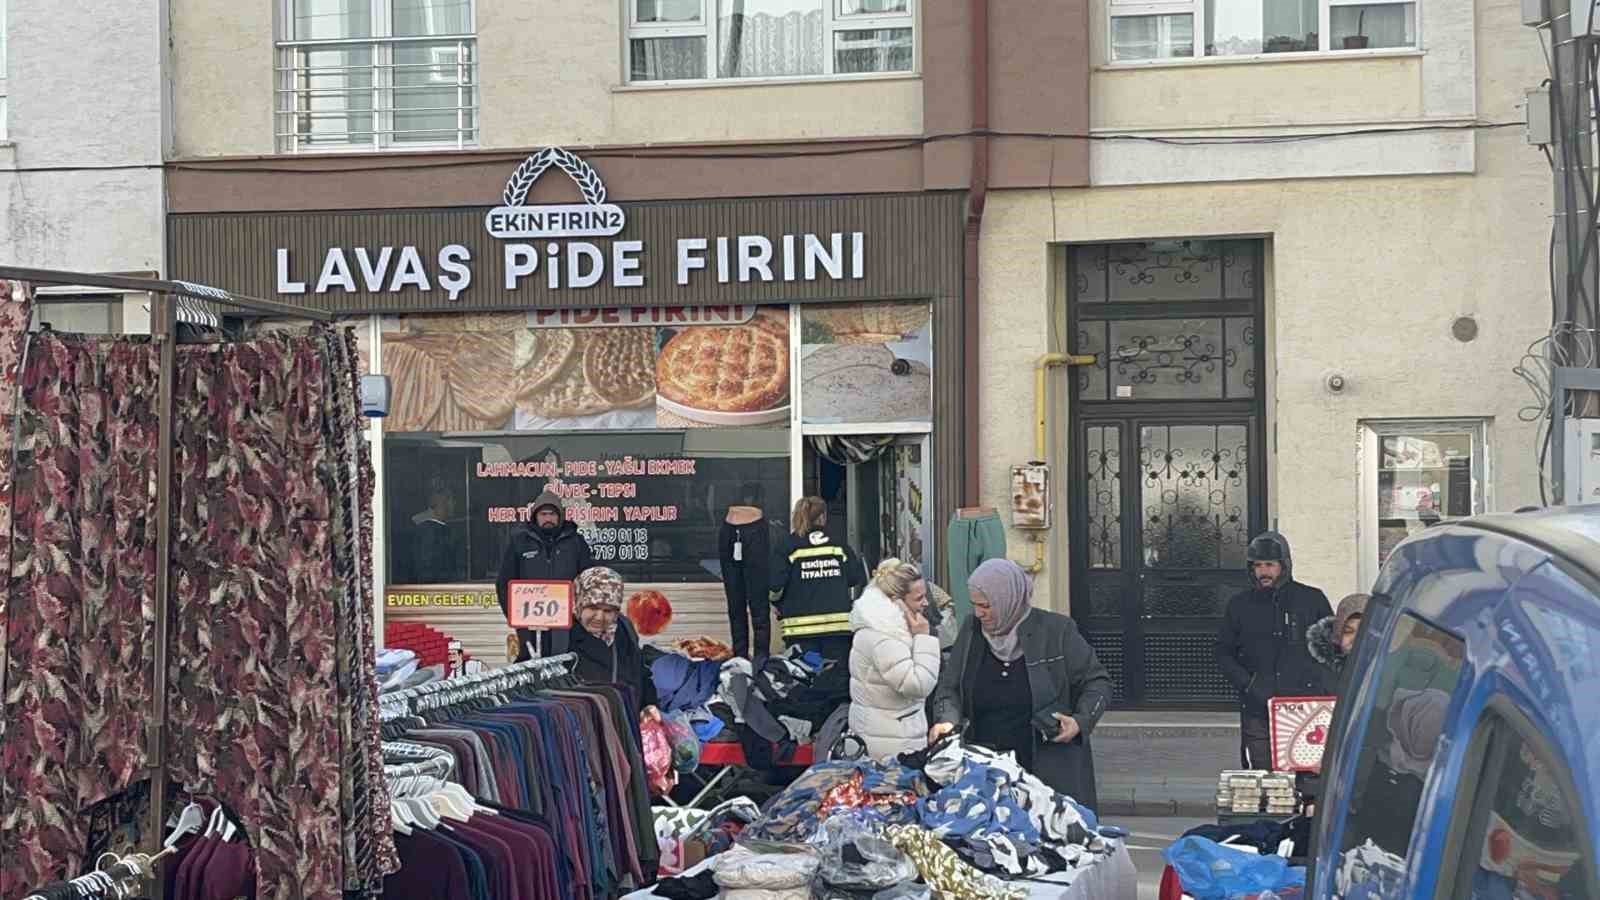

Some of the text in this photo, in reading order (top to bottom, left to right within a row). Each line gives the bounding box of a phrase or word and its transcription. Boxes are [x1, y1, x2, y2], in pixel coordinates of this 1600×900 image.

[276, 243, 472, 301] LAVAŞ
[676, 231, 864, 286] FIRINI
[476, 460, 557, 477] LAHMACUN
[605, 456, 646, 476] YAĞLI
[488, 506, 517, 522] HER
[623, 505, 678, 521] YAPILIR
[387, 593, 429, 607] EVDEN
[433, 593, 474, 607] GELEN
[522, 599, 560, 619] 150
